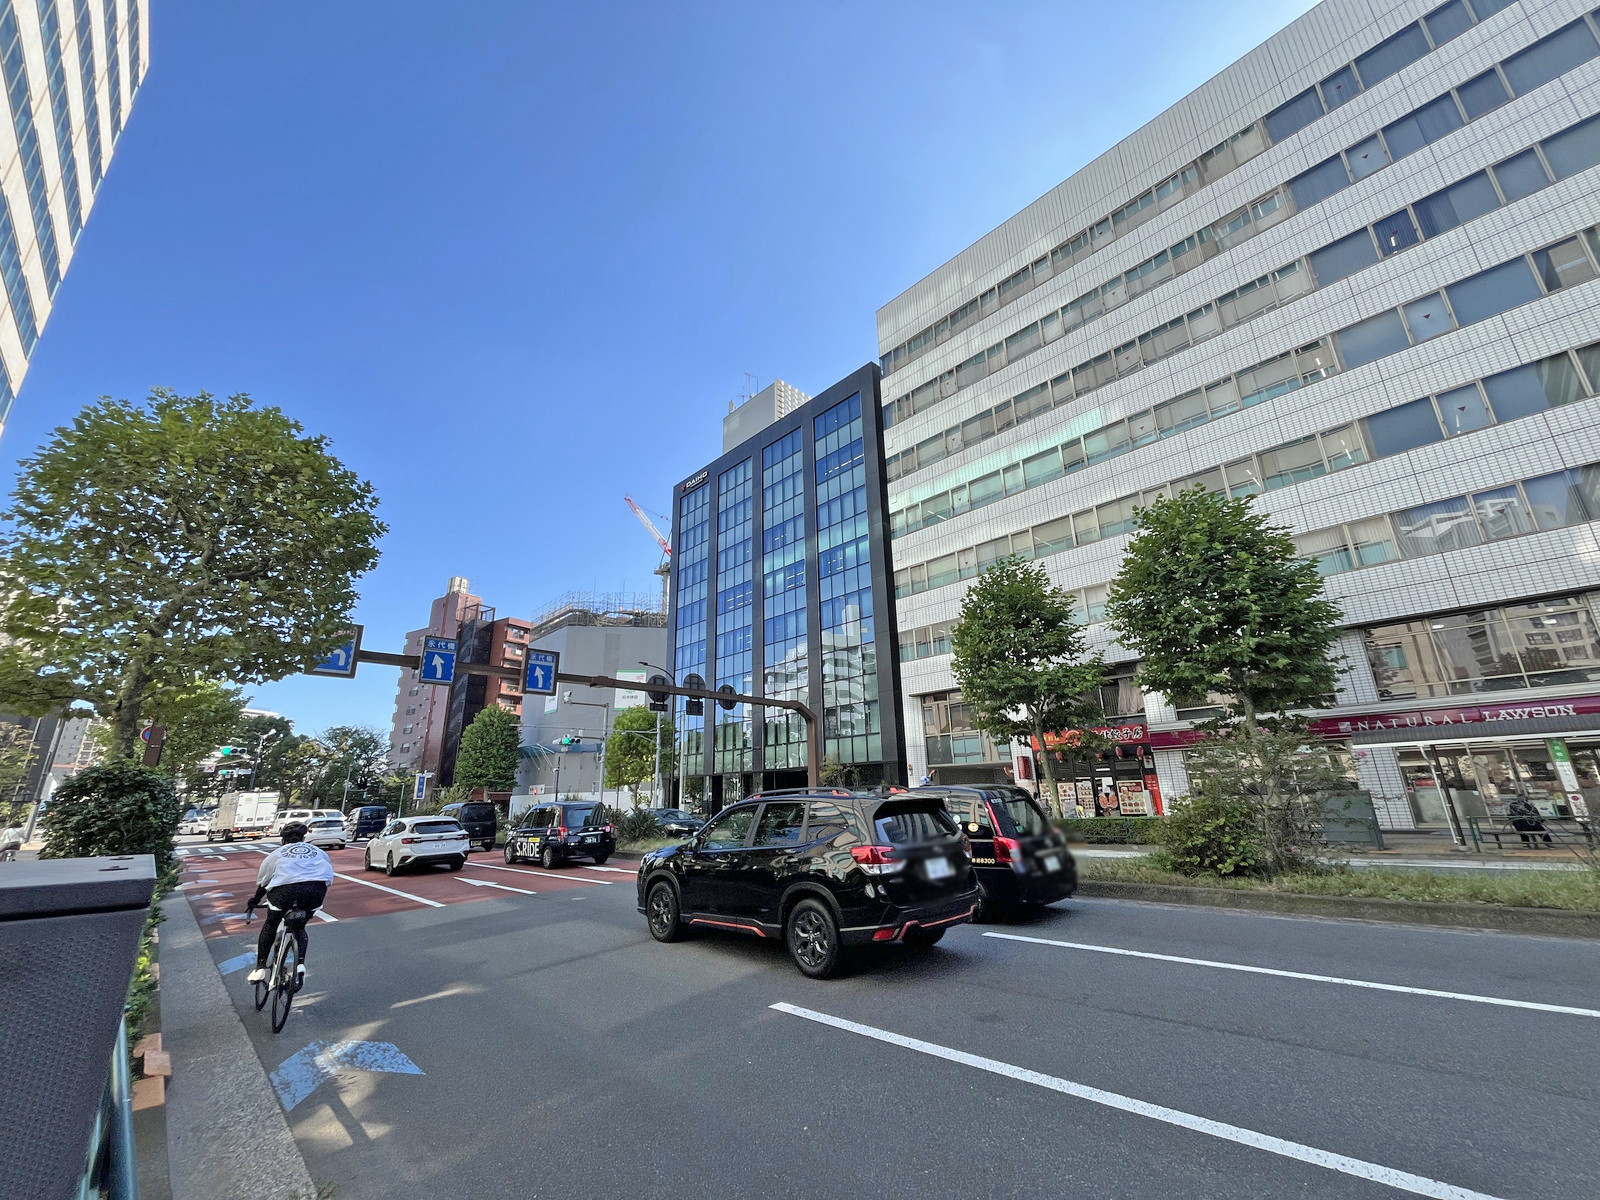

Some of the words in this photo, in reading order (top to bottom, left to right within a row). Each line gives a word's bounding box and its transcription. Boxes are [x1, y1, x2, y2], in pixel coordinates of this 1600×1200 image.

[686, 471, 708, 488] DAIHO
[427, 639, 456, 650] 永代橋
[529, 653, 554, 663] 永代橋
[1357, 713, 1473, 732] NATURAL
[1482, 704, 1577, 722] LAWSON
[516, 841, 540, 858] S.RIDE
